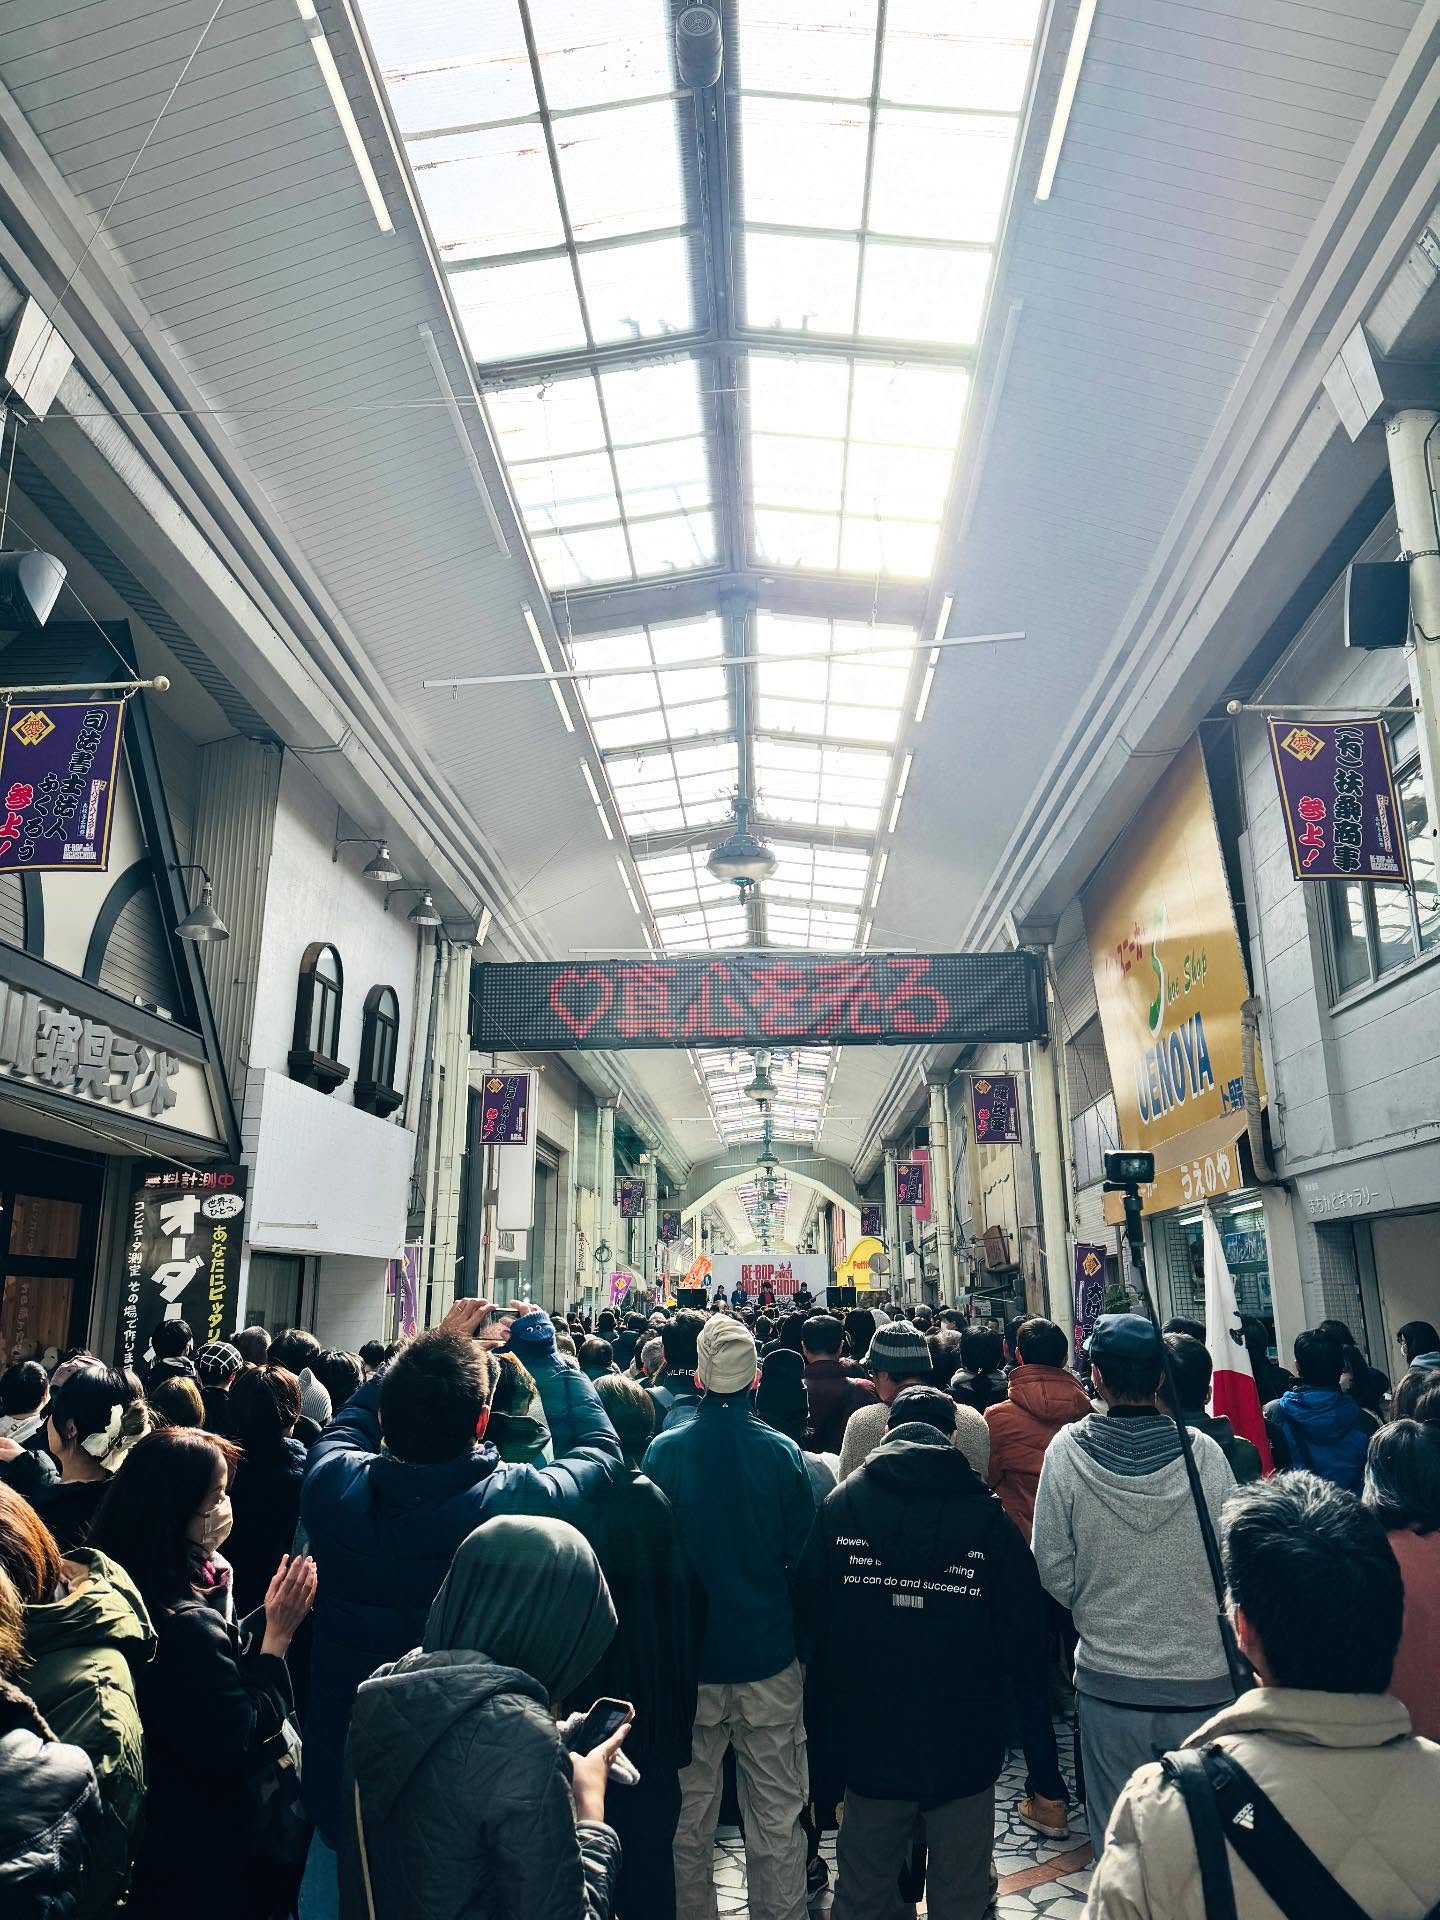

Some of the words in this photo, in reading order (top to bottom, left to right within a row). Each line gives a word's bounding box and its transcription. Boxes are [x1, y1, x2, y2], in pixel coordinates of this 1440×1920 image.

[1184, 945, 1208, 995] Shop
[1134, 1011, 1215, 1125] UENOYA
[1181, 1151, 1231, 1200] うえのや
[143, 1195, 205, 1362] オーダー
[207, 1225, 229, 1345] あなたにピッタリ
[741, 1264, 775, 1280] BE-BOP
[843, 1575, 861, 1585] you
[863, 1576, 881, 1585] can
[884, 1576, 898, 1586] do
[900, 1579, 921, 1589] and
[923, 1581, 967, 1594] succeed
[969, 1588, 982, 1597] at.
[849, 1555, 873, 1566] there
[944, 1565, 975, 1579] thing
